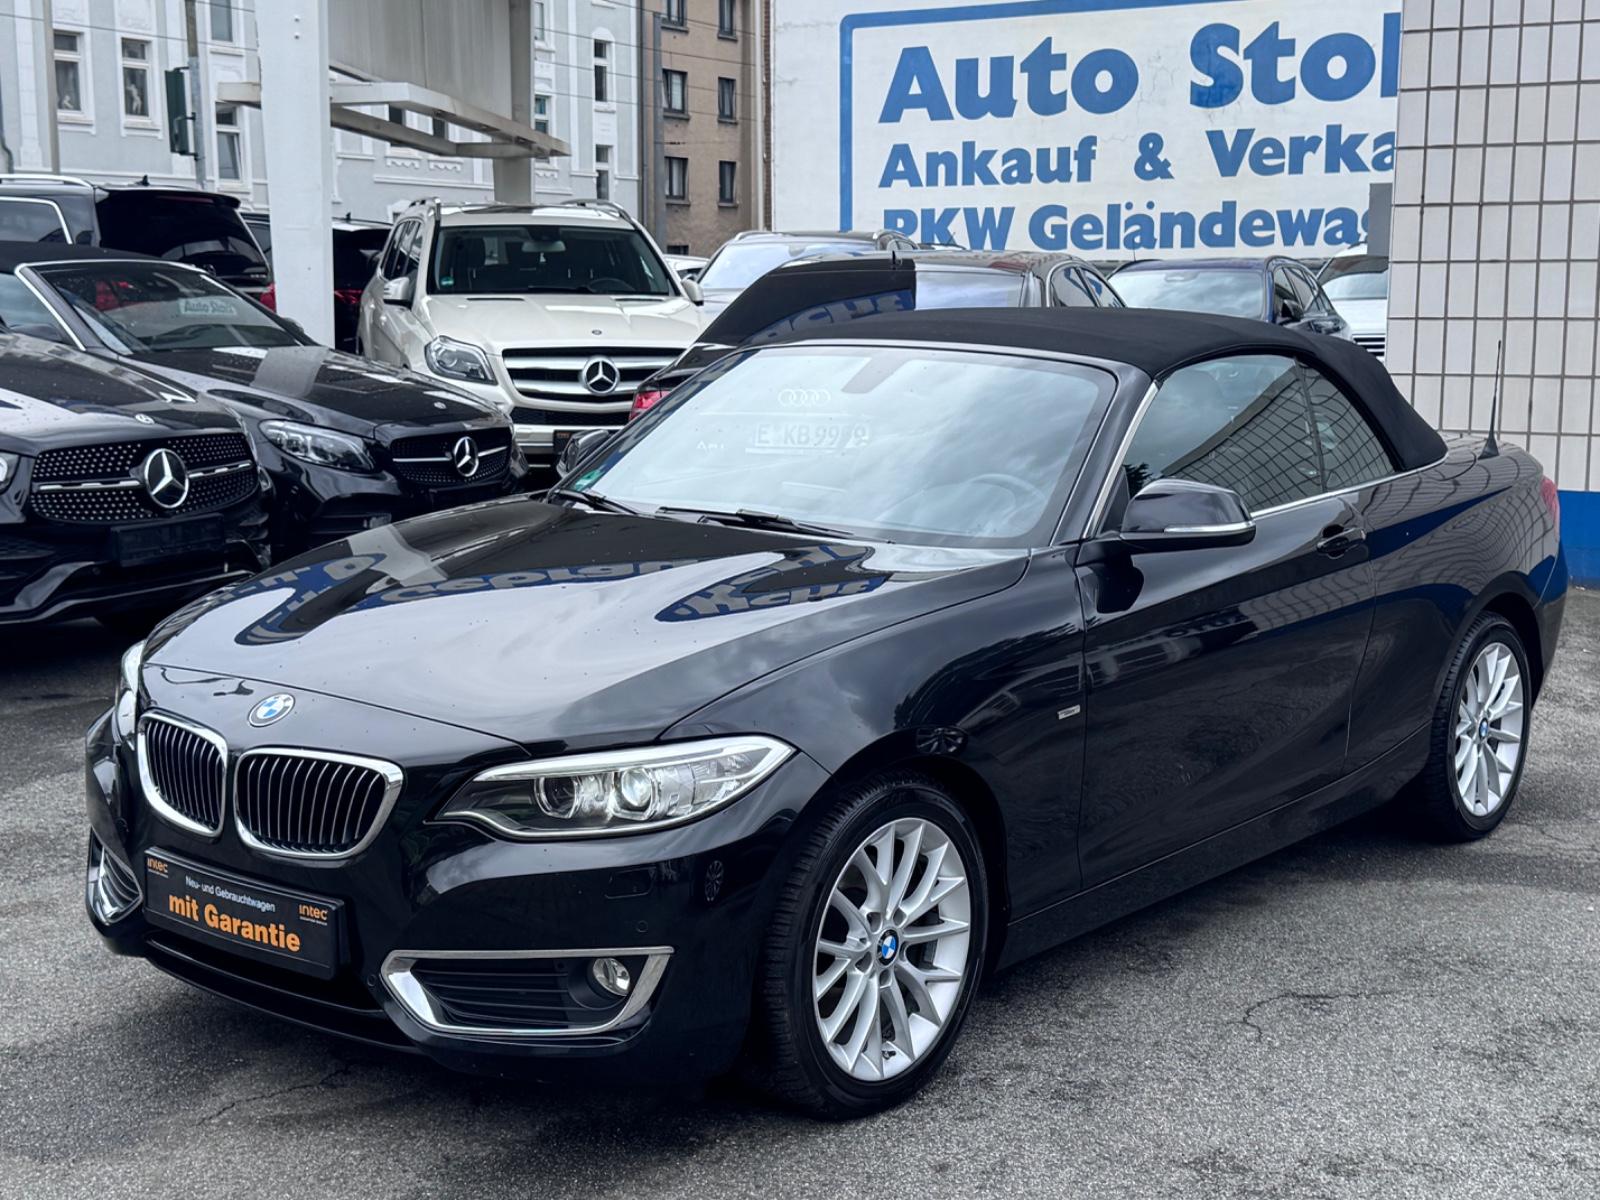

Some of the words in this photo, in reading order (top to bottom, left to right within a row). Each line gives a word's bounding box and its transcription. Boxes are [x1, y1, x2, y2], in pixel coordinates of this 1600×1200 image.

[878, 36, 1140, 123] Auto
[1189, 12, 1401, 107] Stol
[878, 135, 1097, 188] Ankauf
[1133, 132, 1174, 181] &
[1205, 124, 1396, 178] Verka
[883, 206, 1017, 251] PKW
[1028, 200, 1369, 251] Geländewa
[757, 423, 771, 445] E
[783, 423, 811, 446] KB
[185, 876, 200, 889] Neu-
[201, 883, 215, 896] und
[215, 886, 276, 913] Gebrauchtwagen
[168, 894, 199, 922] mit
[204, 903, 301, 953] Garantie
